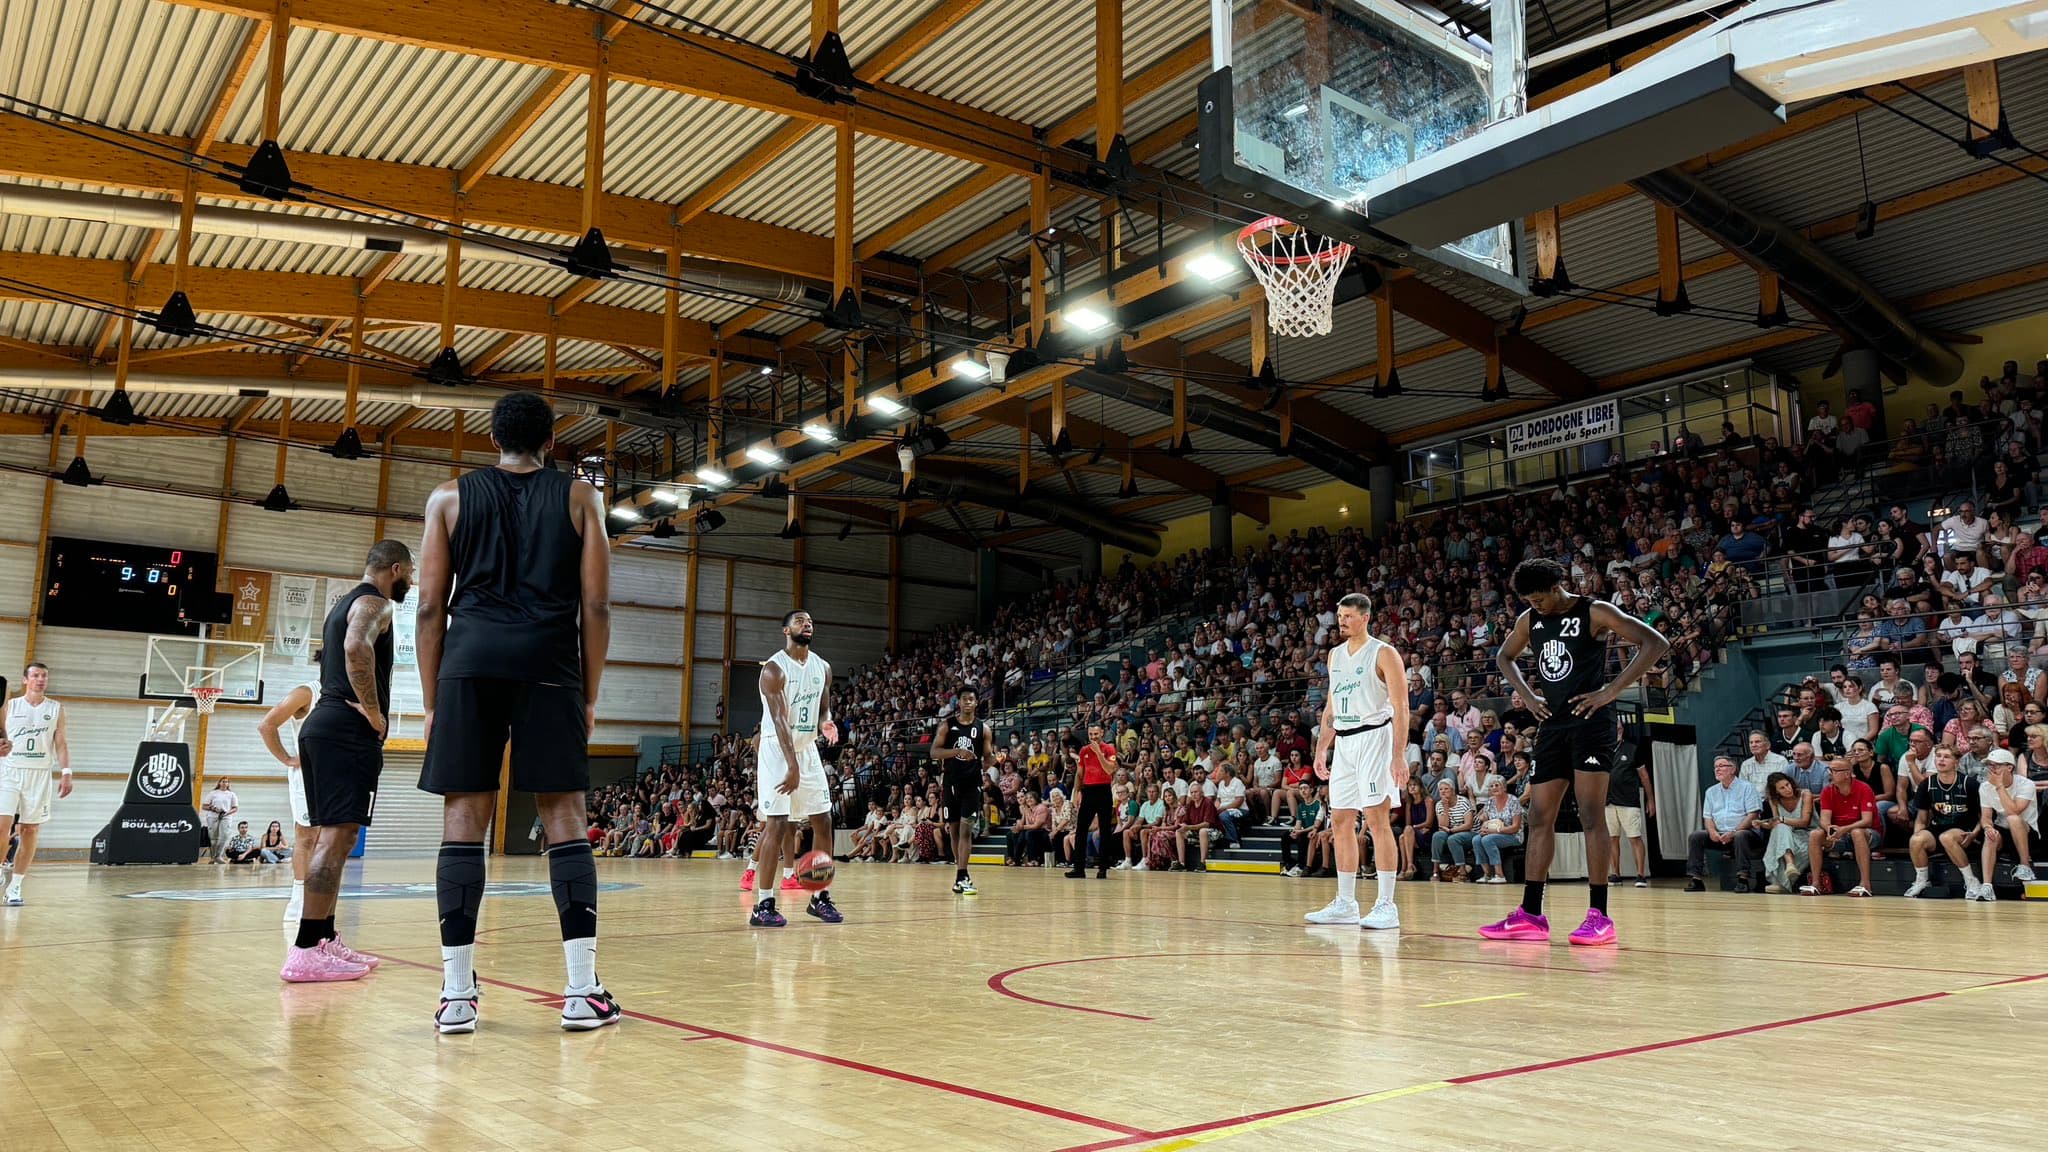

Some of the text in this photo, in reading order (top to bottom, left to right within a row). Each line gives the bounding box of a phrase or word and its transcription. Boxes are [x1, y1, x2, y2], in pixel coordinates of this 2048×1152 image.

[1528, 411, 1583, 438] DORDOGNE
[1586, 403, 1614, 424] LIBRE
[1512, 435, 1562, 453] Partenaire
[1564, 431, 1577, 441] du
[1580, 423, 1606, 439] Sport
[171, 551, 182, 564] 0
[168, 584, 177, 596] 0
[1560, 617, 1580, 637] 23
[283, 636, 300, 645] FFBB
[1543, 640, 1566, 660] BBD
[1341, 697, 1348, 714] 11
[799, 706, 809, 723] 13
[971, 727, 977, 738] 0
[26, 738, 35, 751] 0
[148, 752, 178, 774] BBD
[1369, 782, 1376, 793] 11
[943, 806, 949, 819] 0
[121, 821, 178, 829] BOULAZAC
